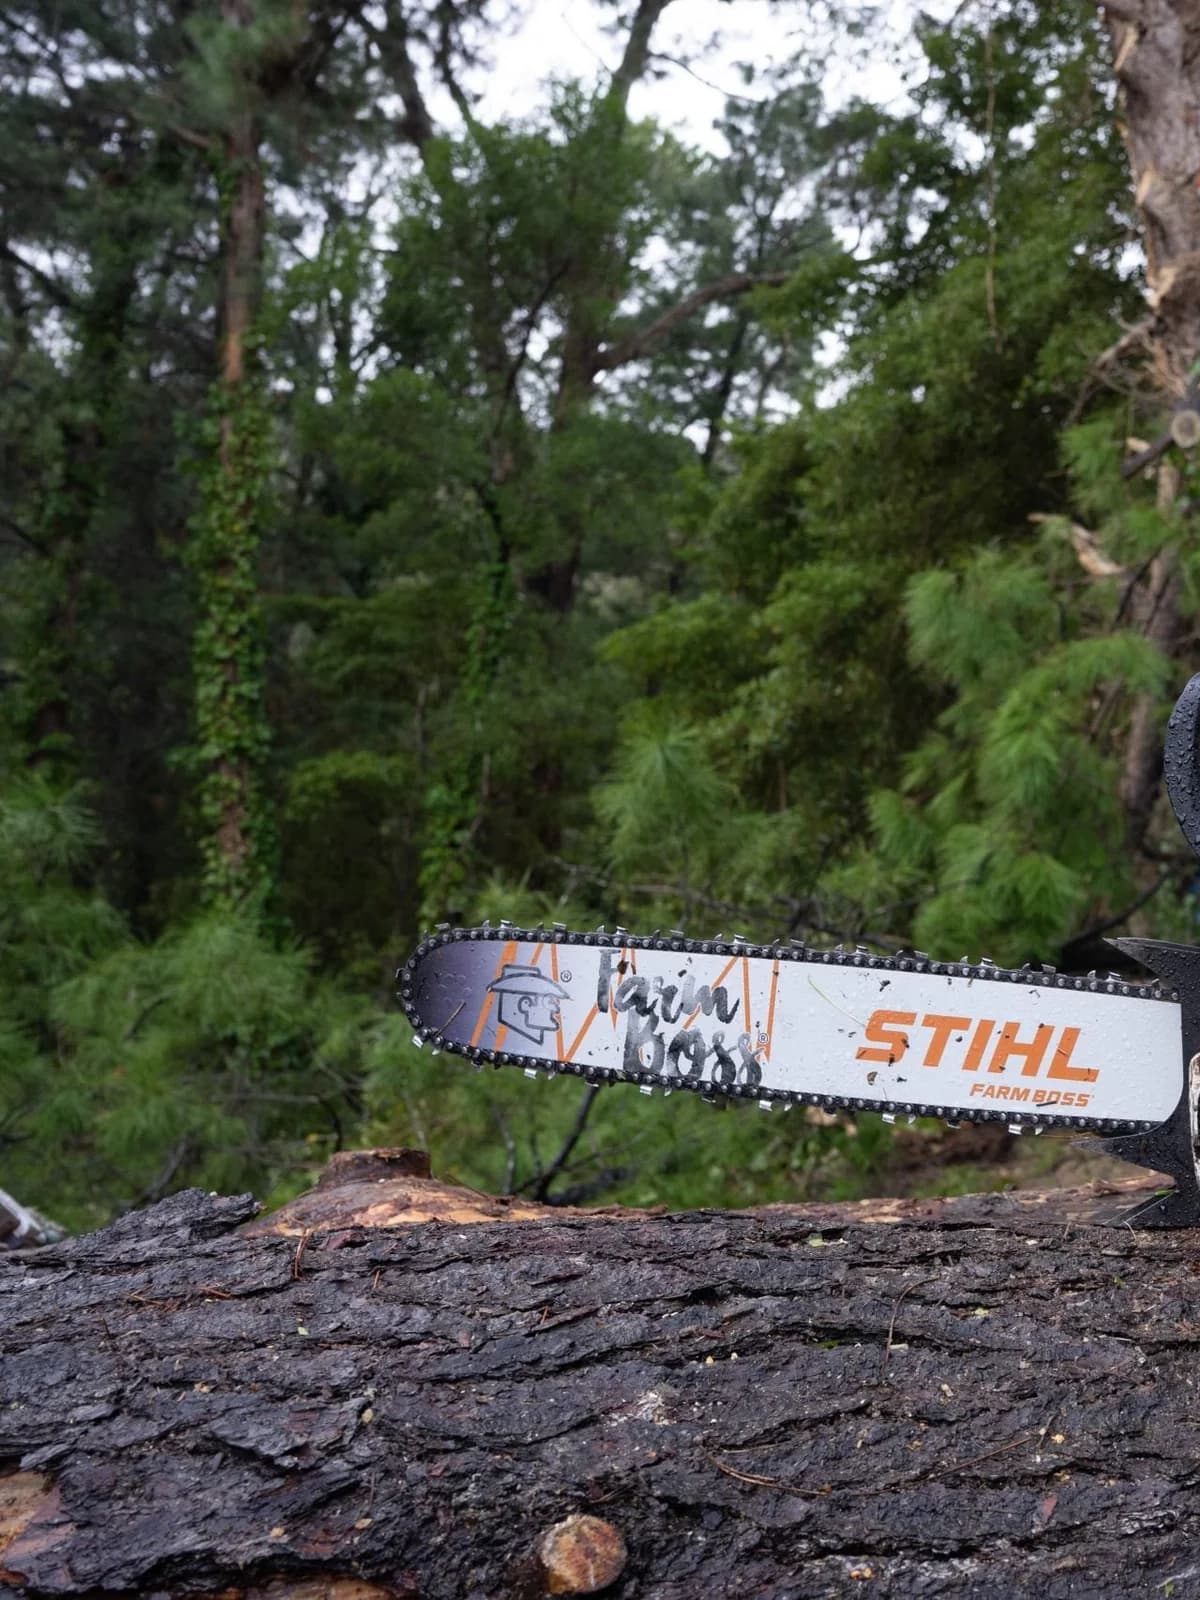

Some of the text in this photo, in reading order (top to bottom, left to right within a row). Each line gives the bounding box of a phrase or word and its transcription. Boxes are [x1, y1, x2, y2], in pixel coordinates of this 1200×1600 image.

[856, 1009, 1099, 1083] STIHL
[969, 1083, 1091, 1107] FARM BOSS
